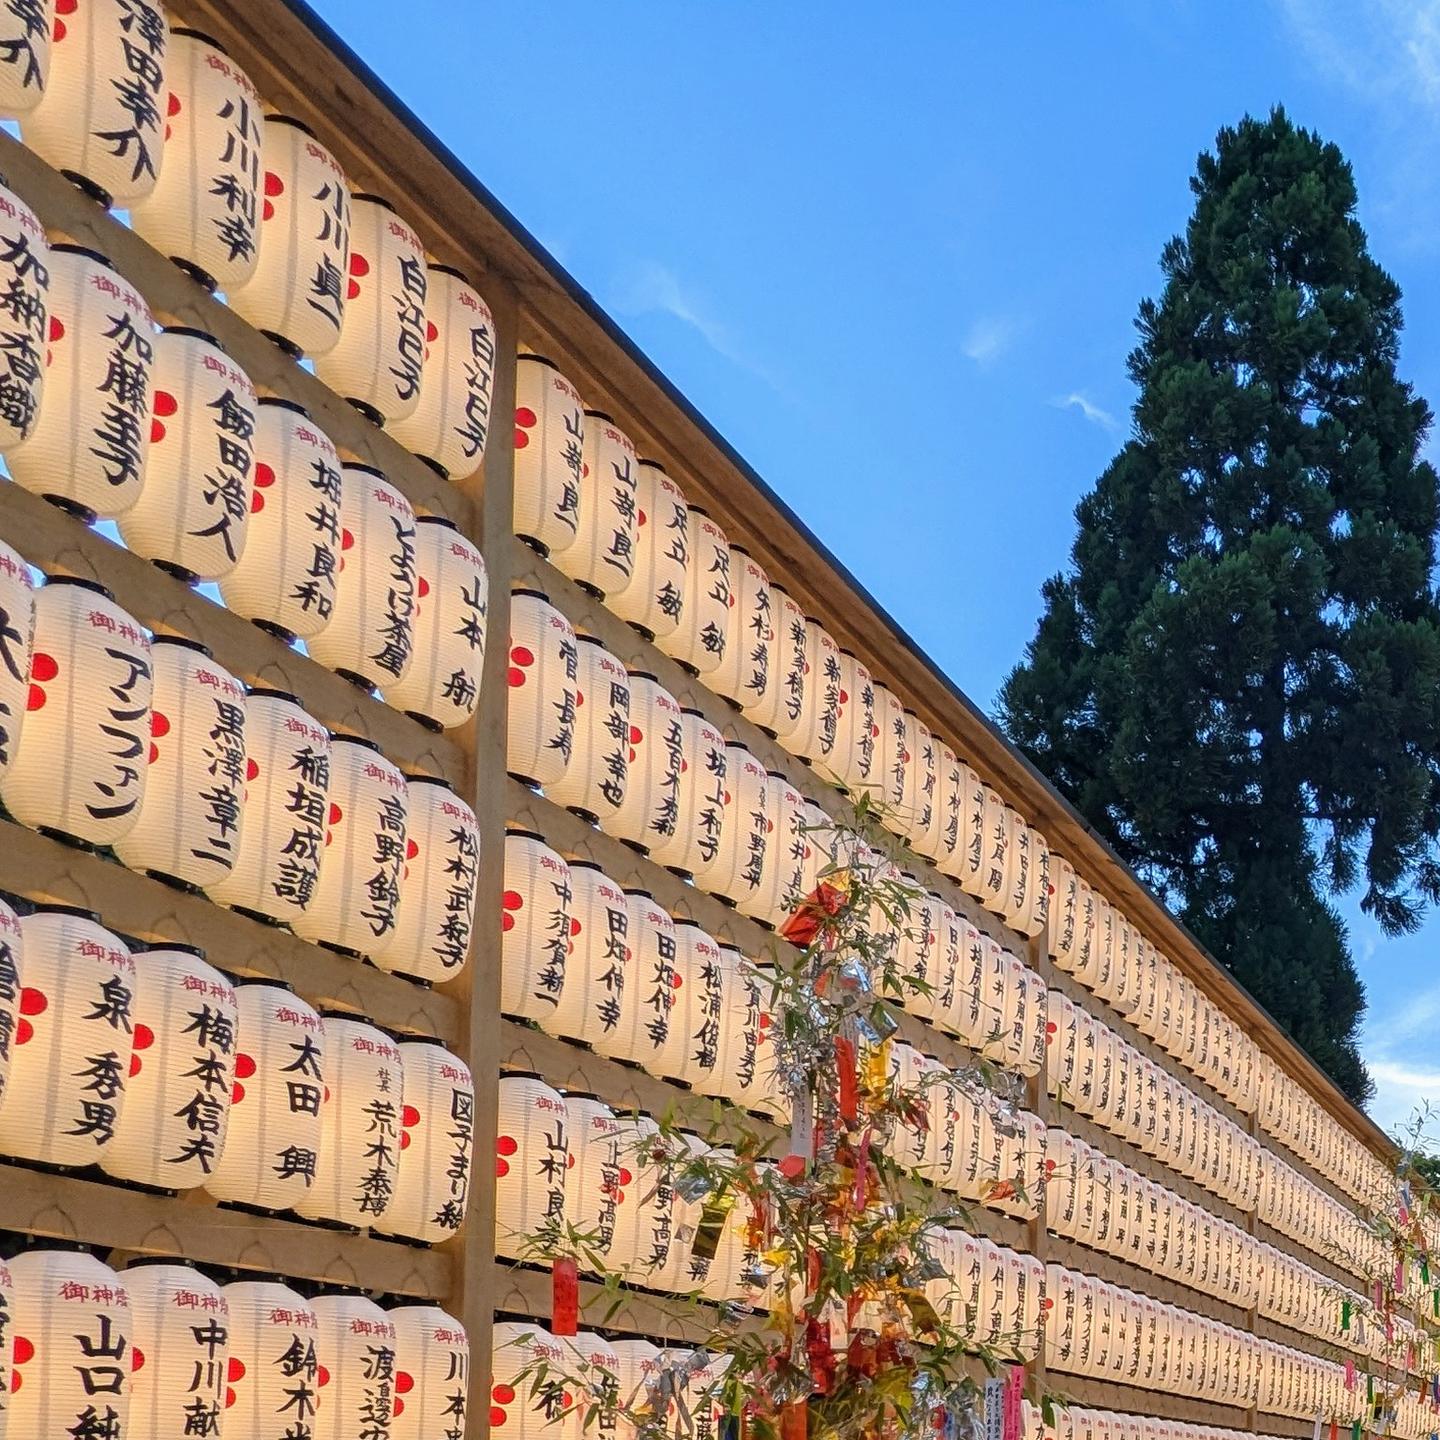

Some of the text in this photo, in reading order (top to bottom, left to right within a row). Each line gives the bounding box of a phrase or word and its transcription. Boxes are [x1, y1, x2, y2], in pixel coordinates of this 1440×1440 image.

[208, 96, 261, 264] 小川利幸
[89, 311, 153, 487] 加藤至子
[187, 388, 256, 562] 飯田浩人
[289, 458, 341, 621] 堀井良和
[85, 647, 150, 819] アンファン
[191, 699, 246, 871] 黒澤章二
[599, 682, 629, 806] 岡部幸也
[698, 748, 726, 861] 坂上和子
[535, 882, 571, 1004] 中須賀新一
[597, 908, 627, 1030] 田畑伸幸
[645, 932, 676, 1047] 田畑伸幸
[60, 973, 133, 1147] 泉秀男
[163, 1003, 235, 1175] 梅本信夫
[353, 1099, 397, 1218] 荒木泰博
